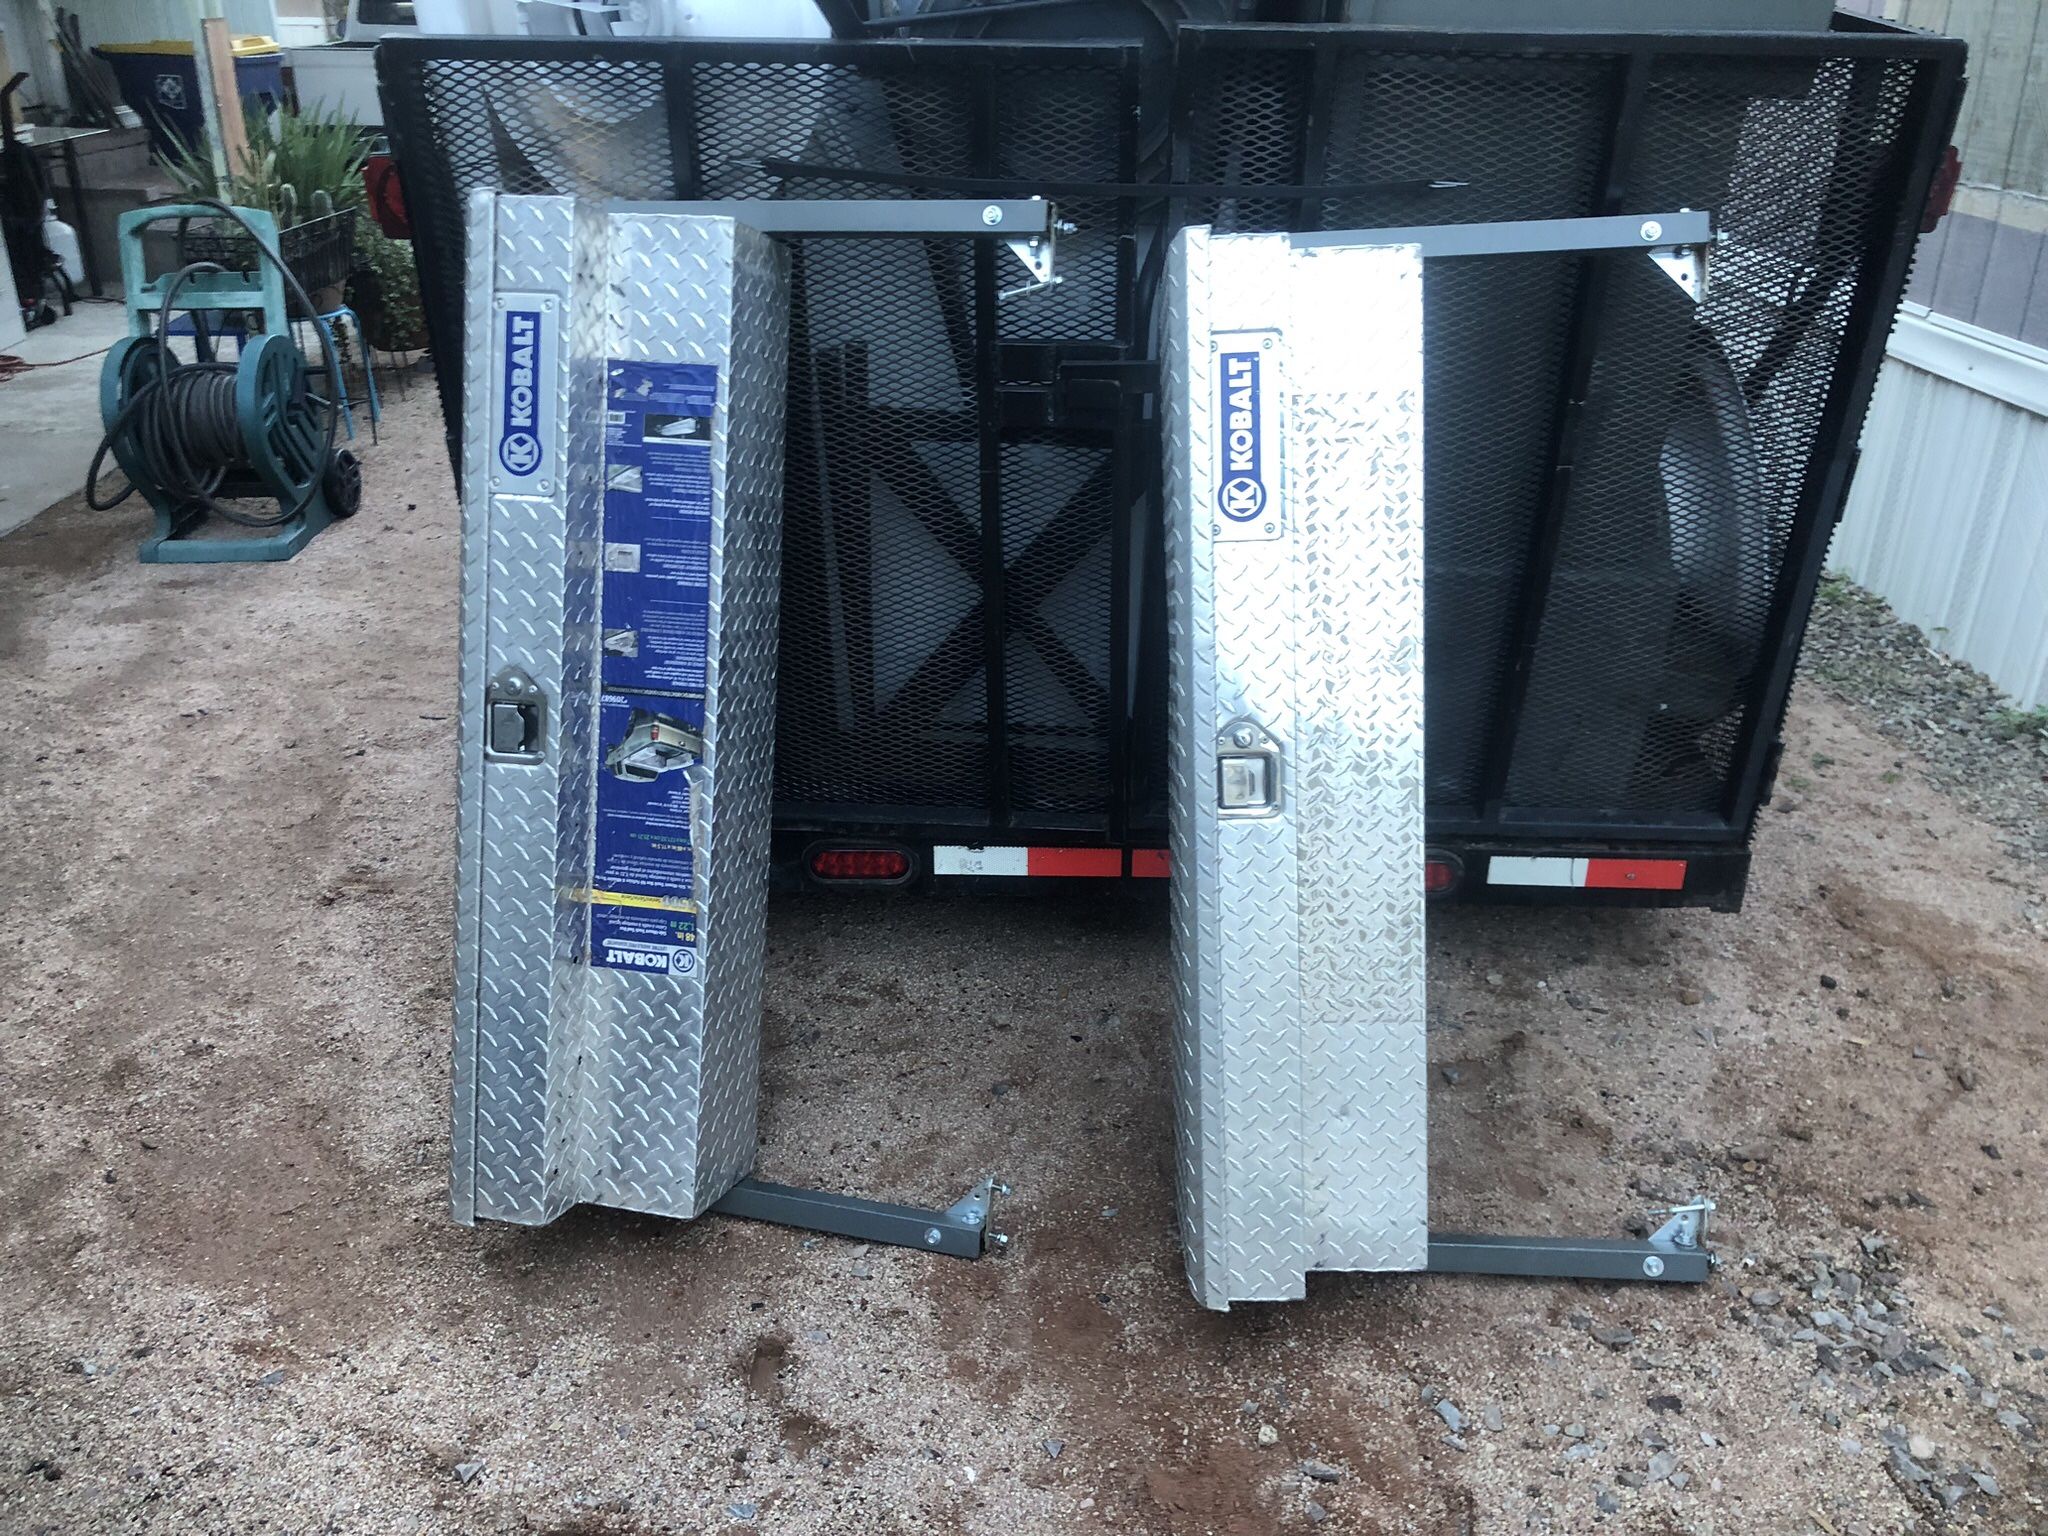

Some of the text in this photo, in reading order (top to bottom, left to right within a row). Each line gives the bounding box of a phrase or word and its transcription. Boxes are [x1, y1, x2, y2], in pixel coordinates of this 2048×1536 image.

[510, 316, 535, 427] KOBALT
[1228, 357, 1254, 472] KOBALT
[606, 949, 667, 968] KOBALT
[685, 932, 695, 942] 48
